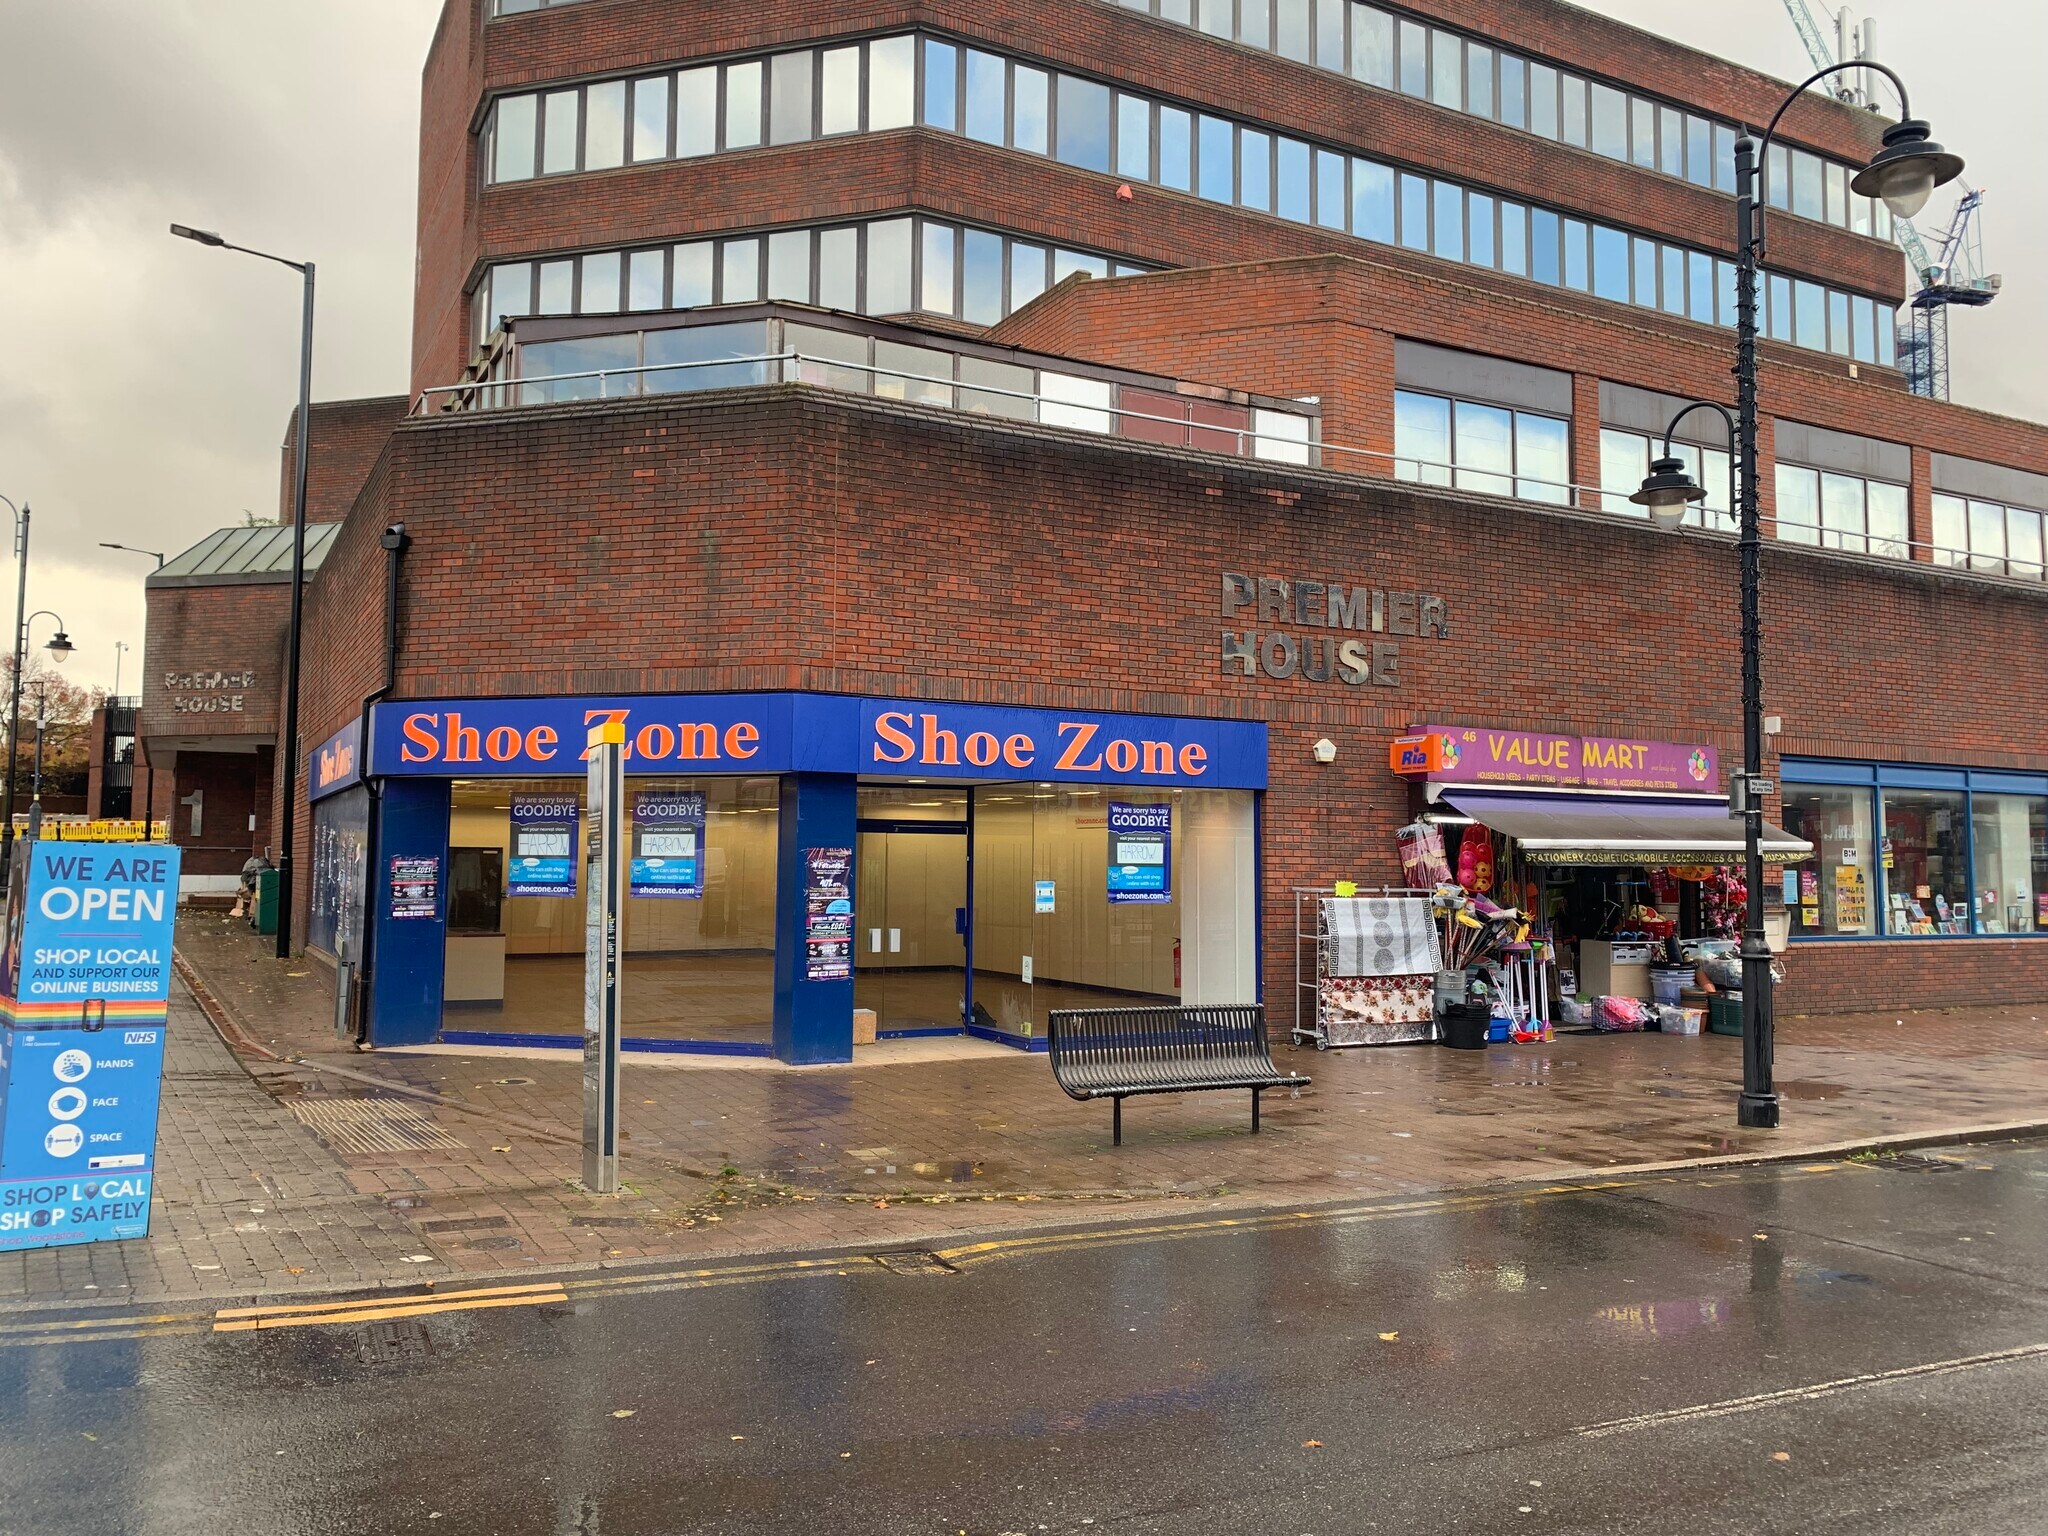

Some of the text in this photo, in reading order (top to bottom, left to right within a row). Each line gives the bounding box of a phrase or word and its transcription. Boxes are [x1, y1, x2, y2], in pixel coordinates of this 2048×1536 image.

[1222, 571, 1449, 640] PREMIER
[1221, 628, 1400, 687] HOUSE
[164, 671, 256, 691] PREMIER
[174, 694, 243, 713] HOUSE
[401, 709, 760, 763] Shoe Zone
[873, 711, 1208, 776] Shoe Zone
[1401, 745, 1427, 765] Ria
[1462, 731, 1649, 769] 46 VALUE MART
[1477, 771, 1505, 780] HOUSEHOLD
[1505, 773, 1521, 781] NEEDS
[1526, 773, 1540, 781] PARTY
[1541, 774, 1555, 783] ITEMS
[1560, 775, 1580, 784] LUGGAGE
[1587, 777, 1598, 786] BAGS
[1603, 778, 1618, 787] TRAVEL
[181, 789, 203, 837] 1
[513, 804, 576, 817] GOODBYE
[637, 804, 702, 816] GOODBYE
[1158, 808, 1169, 816] say
[1112, 814, 1169, 827] GOODBYE
[642, 836, 692, 854] HARROW
[1671, 853, 1724, 863] ACCESSORIES
[1727, 853, 1734, 863] &
[1763, 853, 1785, 862] MUCH
[45, 856, 167, 882] WE ARE
[516, 885, 569, 893] shoezone.com
[639, 886, 695, 895] shoezone.com
[1116, 892, 1164, 900] shoezone.com
[40, 886, 164, 921] OPEN
[34, 949, 160, 964] SHOP LOCAL
[32, 967, 160, 979] AND SUPPORT OUR
[31, 981, 158, 993] ONLINE BUSINESS
[125, 1032, 155, 1043] NHS
[97, 1059, 134, 1069] HANDS
[92, 1097, 119, 1107] FACE
[90, 1132, 122, 1142] SPACE
[4, 1184, 67, 1206] SHOP
[71, 1201, 145, 1224] SAFELY
